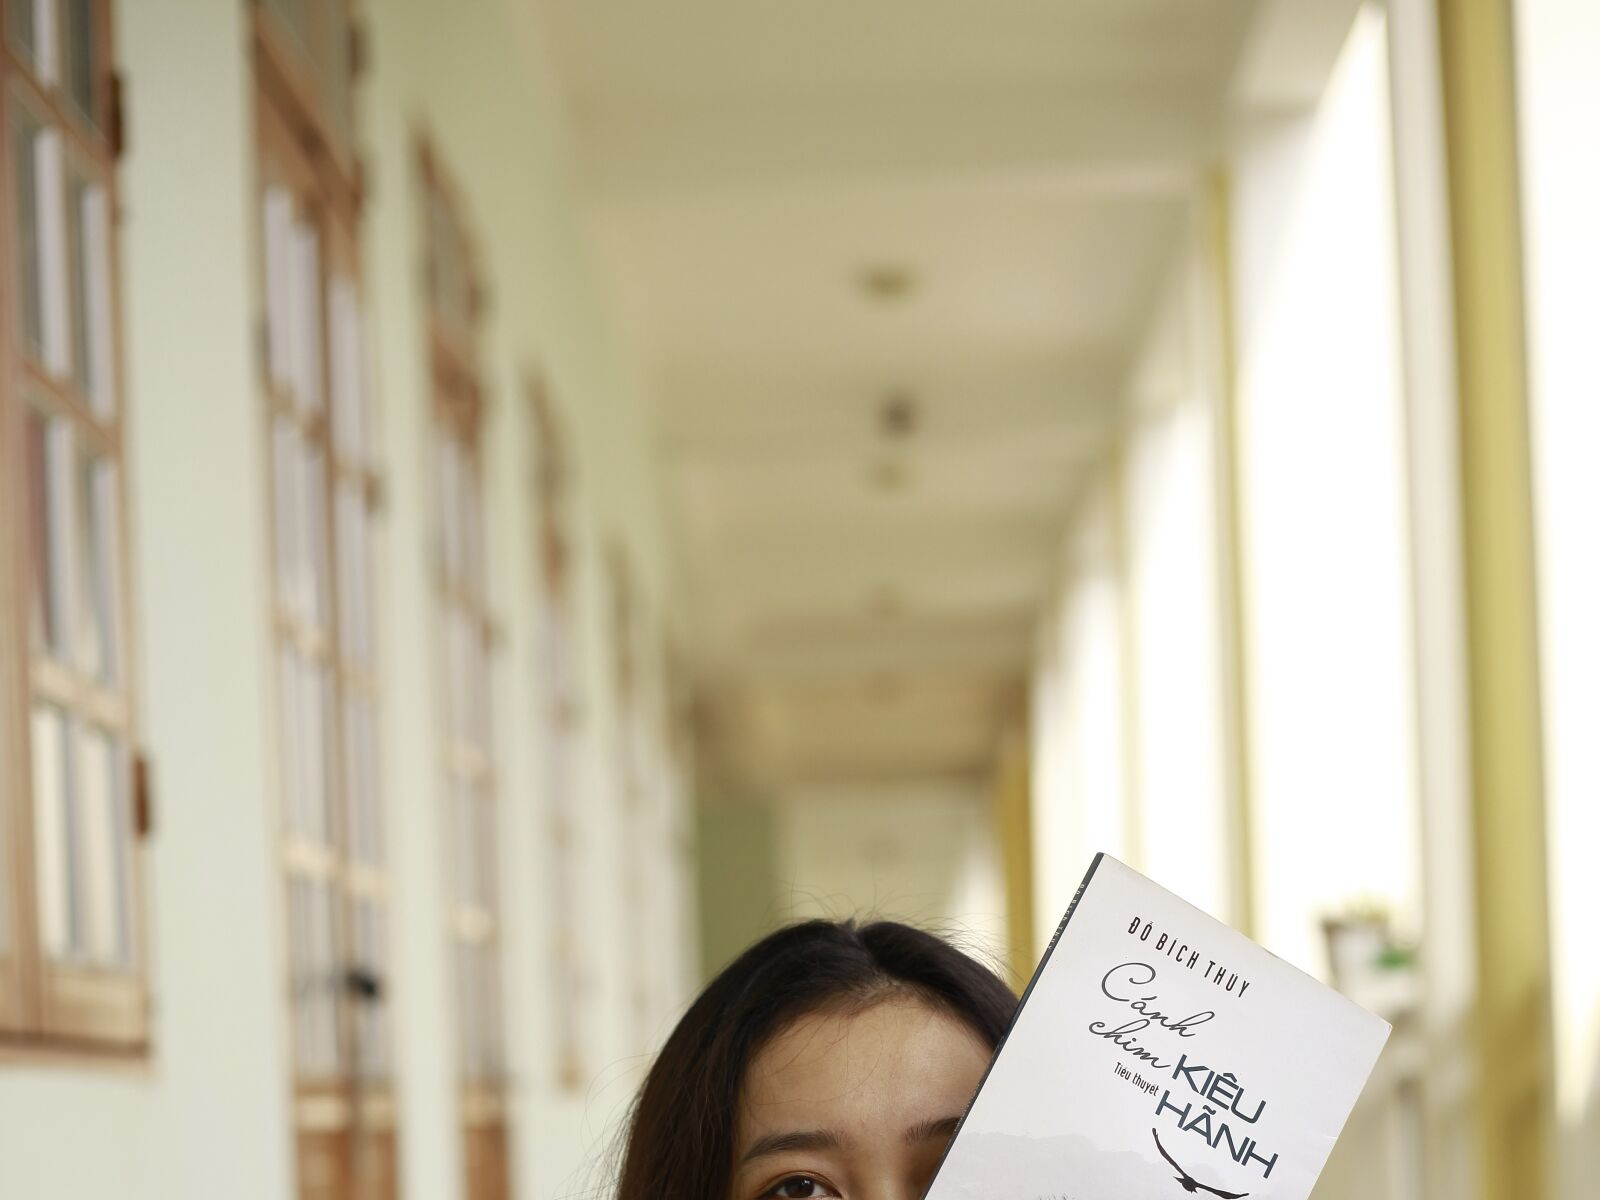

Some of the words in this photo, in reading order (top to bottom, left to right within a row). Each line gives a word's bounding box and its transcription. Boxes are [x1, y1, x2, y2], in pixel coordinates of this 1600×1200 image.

[1101, 962, 1216, 1038] Cánh
[1155, 932, 1200, 970] BÍCH
[1204, 960, 1251, 998] THÚY
[1088, 1018, 1172, 1069] chim
[1172, 1053, 1267, 1124] KIÊU
[1155, 1089, 1279, 1179] HÃNH
